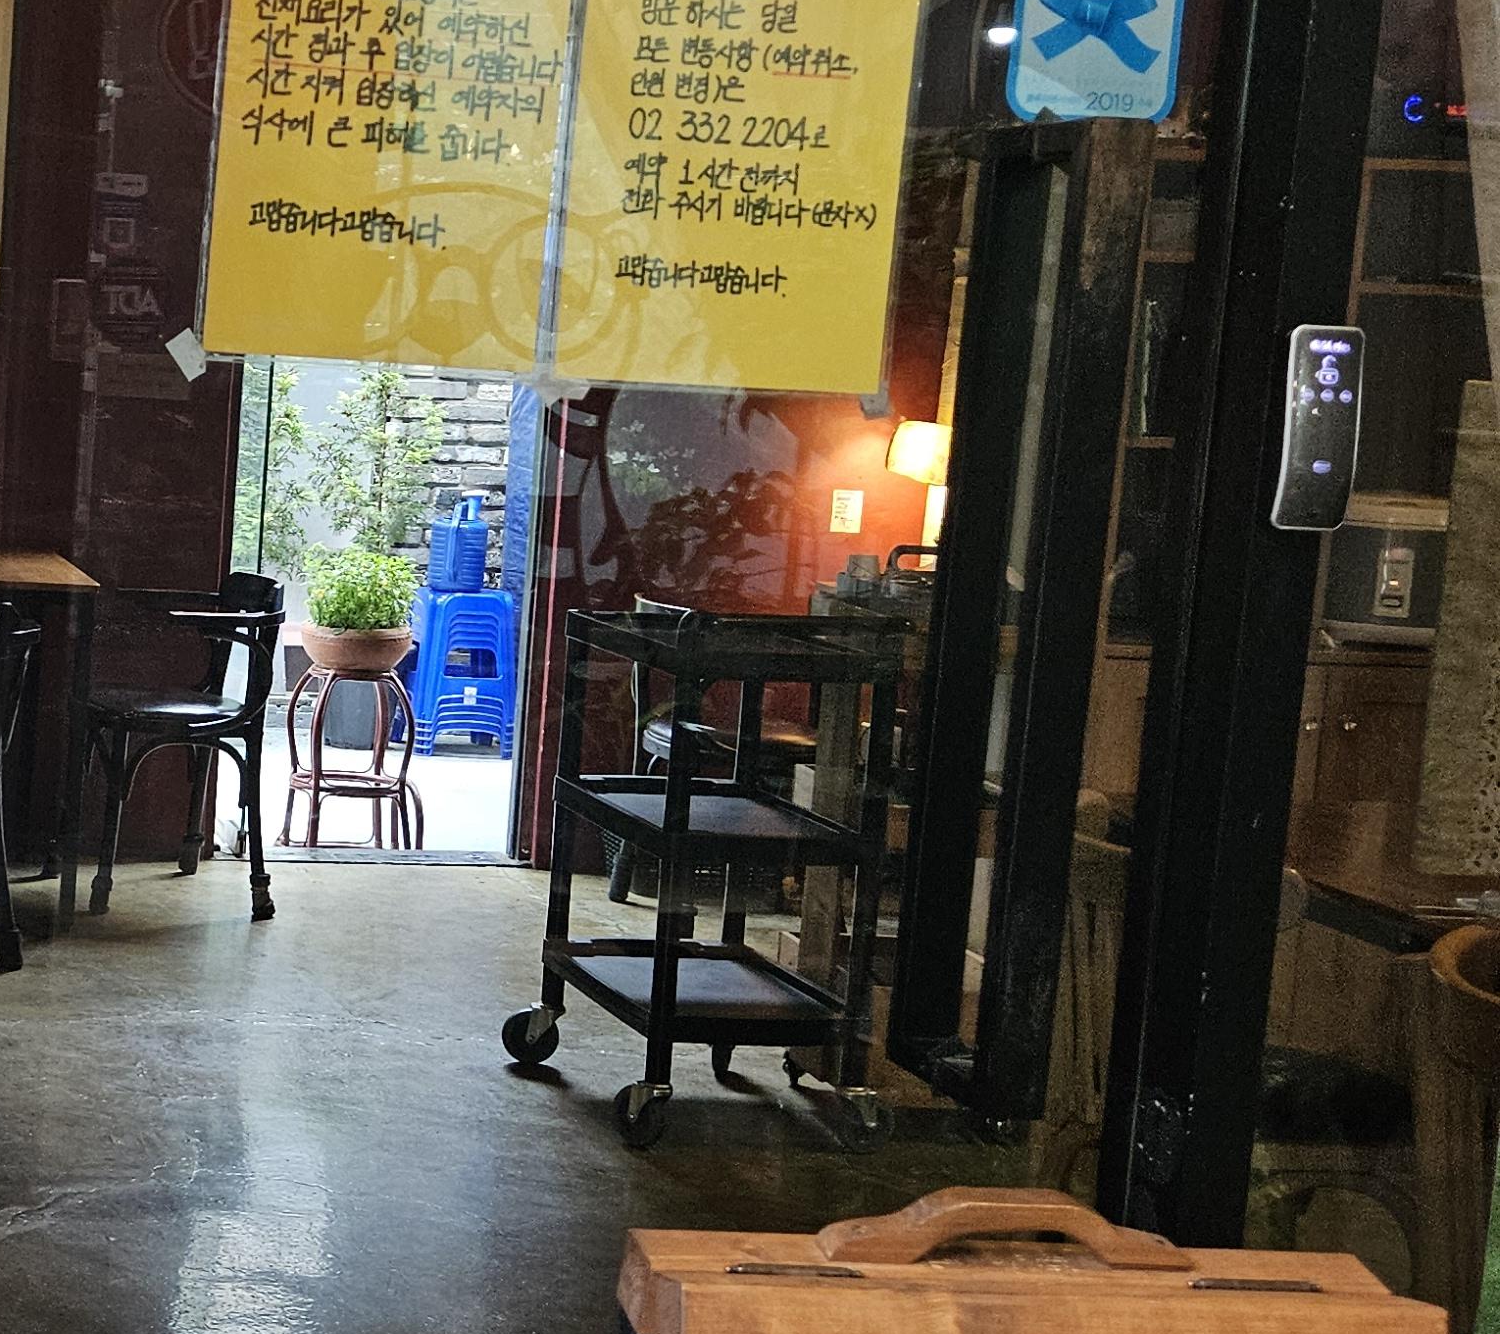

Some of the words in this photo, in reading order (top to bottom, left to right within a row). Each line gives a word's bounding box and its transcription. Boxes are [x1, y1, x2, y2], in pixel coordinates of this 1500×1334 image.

[437, 8, 532, 48] 예약하신
[761, 0, 798, 33] 당일
[251, 23, 299, 60] 시간
[309, 26, 355, 66] 경과
[360, 37, 385, 70] 후
[395, 36, 454, 79] 입장이
[633, 34, 670, 63] 모든
[681, 34, 760, 73] 변동사항
[246, 63, 296, 98] 시간
[301, 67, 345, 105] 지켜
[357, 72, 436, 111] 입장하신
[452, 85, 544, 124] 예약자의
[630, 68, 666, 98] 인원
[1085, 90, 1134, 112] 2019
[241, 103, 314, 146] 식사에
[327, 116, 352, 147] 큰
[361, 116, 429, 152] 피해를
[628, 107, 662, 141] 02
[676, 110, 731, 144] 332
[624, 152, 668, 187] 예약
[621, 187, 665, 219] 전화
[668, 190, 722, 222] 주시기
